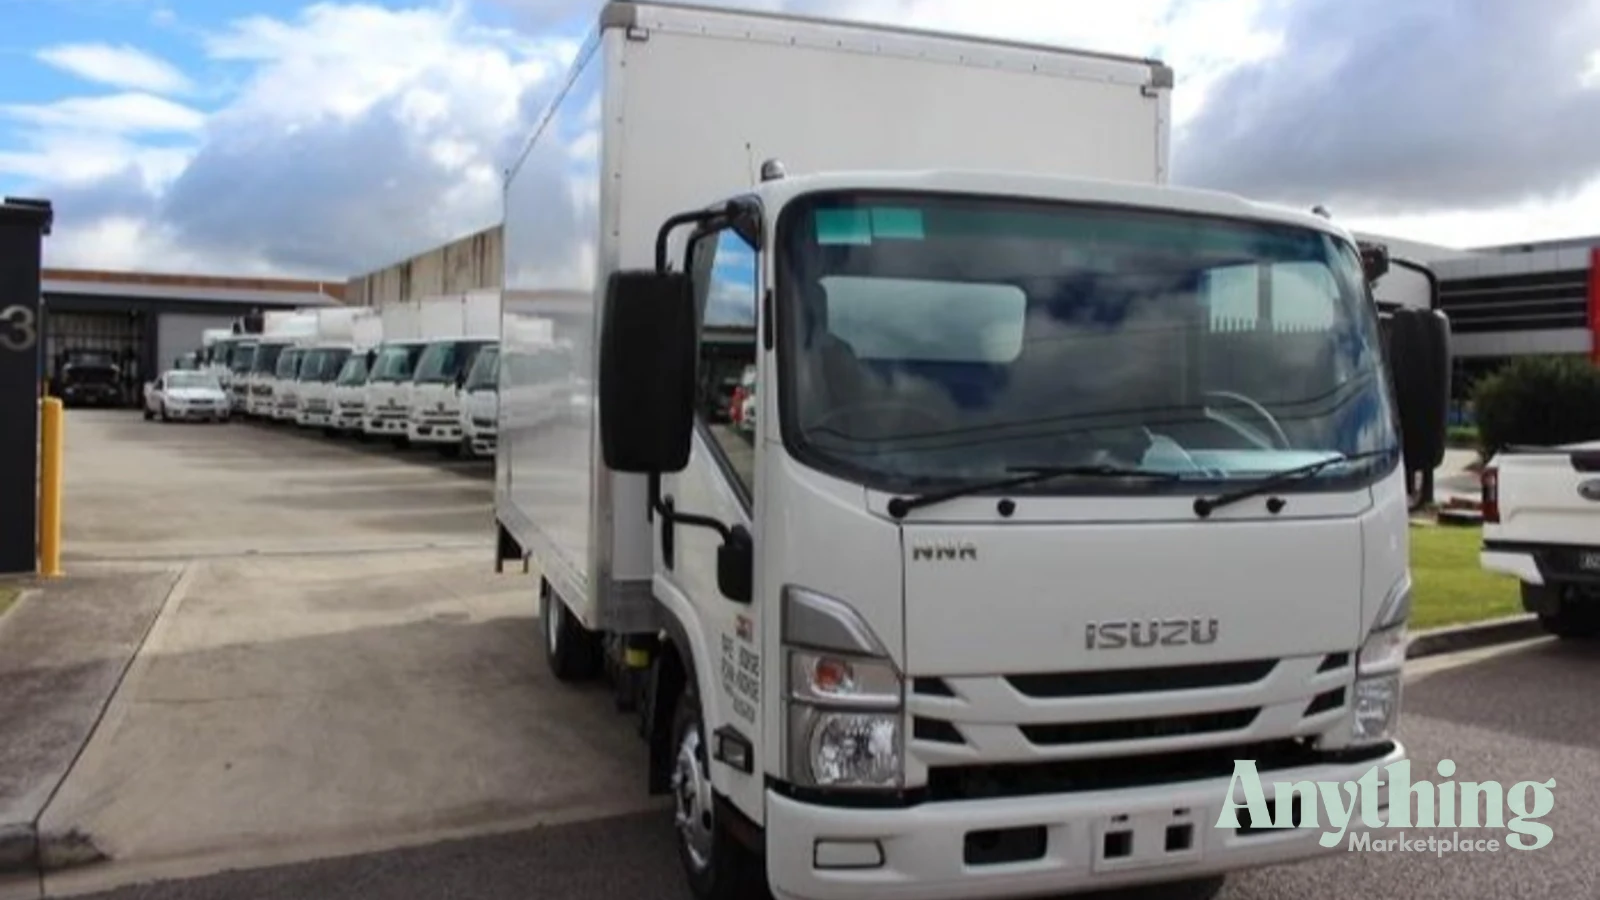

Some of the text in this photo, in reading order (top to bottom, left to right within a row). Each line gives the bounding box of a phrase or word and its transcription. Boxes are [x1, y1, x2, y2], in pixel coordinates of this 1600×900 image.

[0, 304, 35, 351] 3
[913, 546, 977, 561] NNR
[1085, 619, 1219, 650] ISUZU
